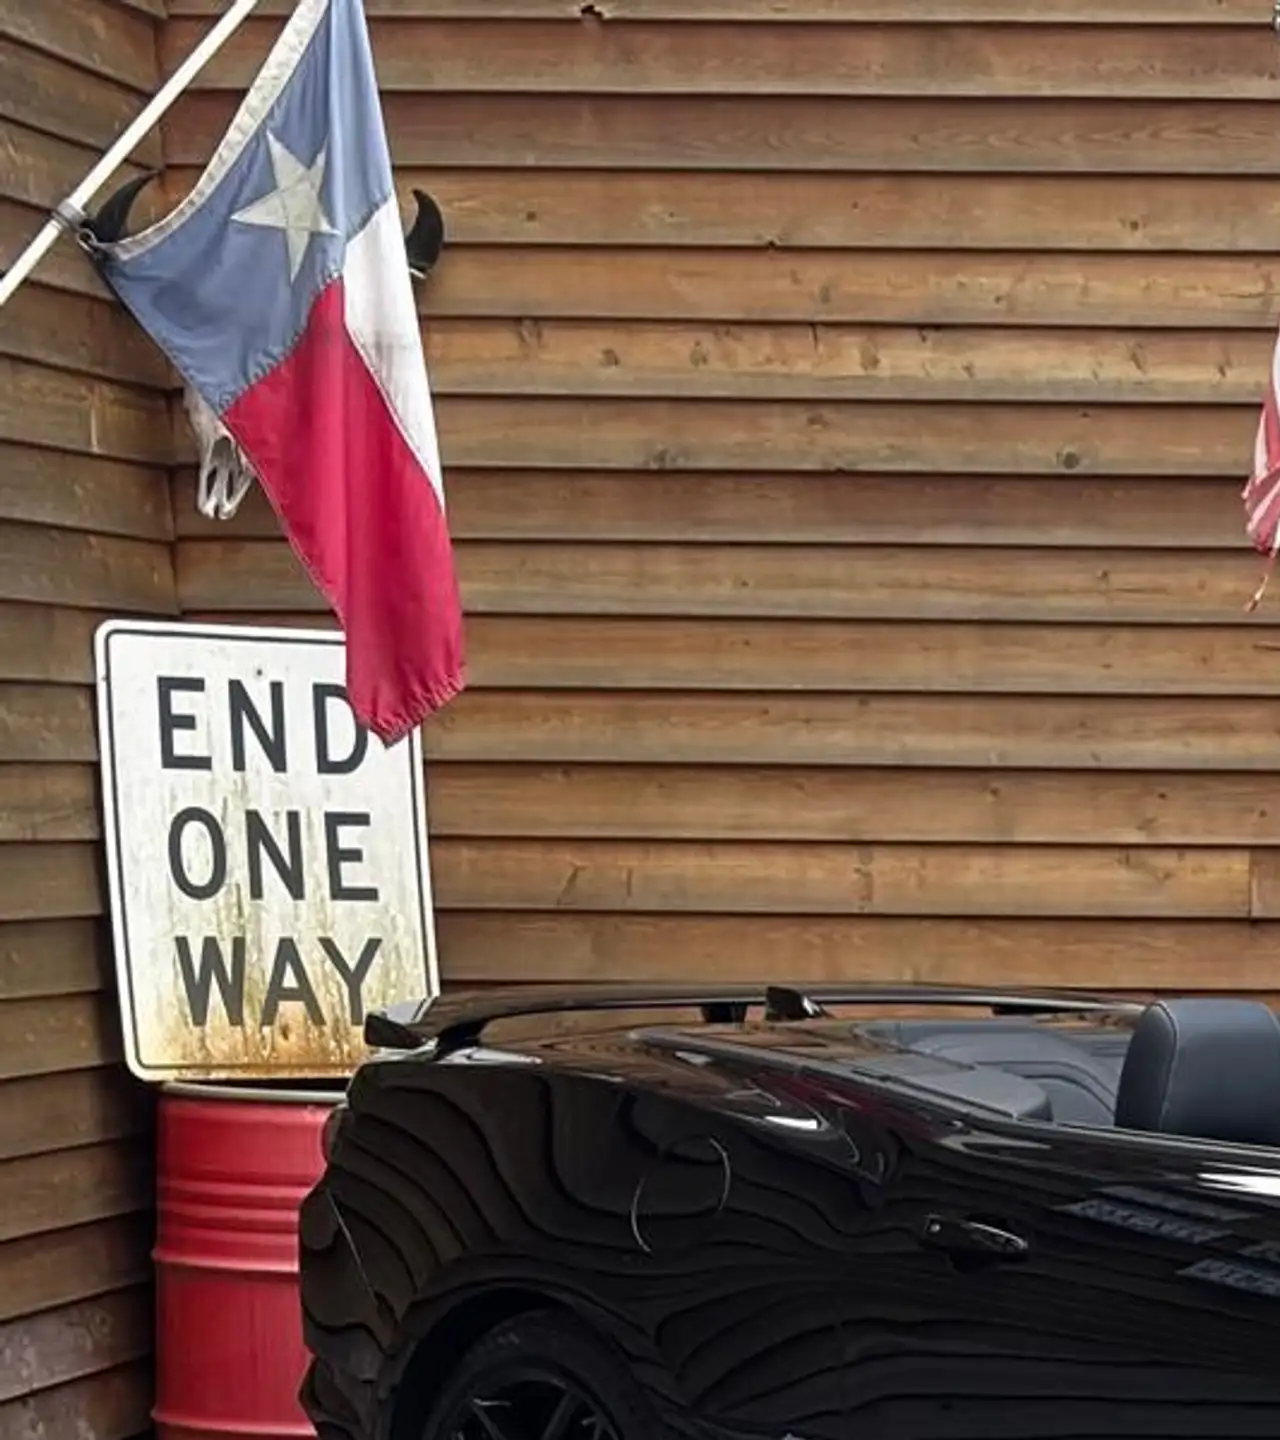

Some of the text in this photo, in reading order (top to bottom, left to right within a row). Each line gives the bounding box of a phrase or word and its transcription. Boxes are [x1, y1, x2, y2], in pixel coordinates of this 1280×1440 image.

[156, 676, 368, 776] END
[167, 806, 380, 903] ONE
[174, 935, 384, 1028] WAY
